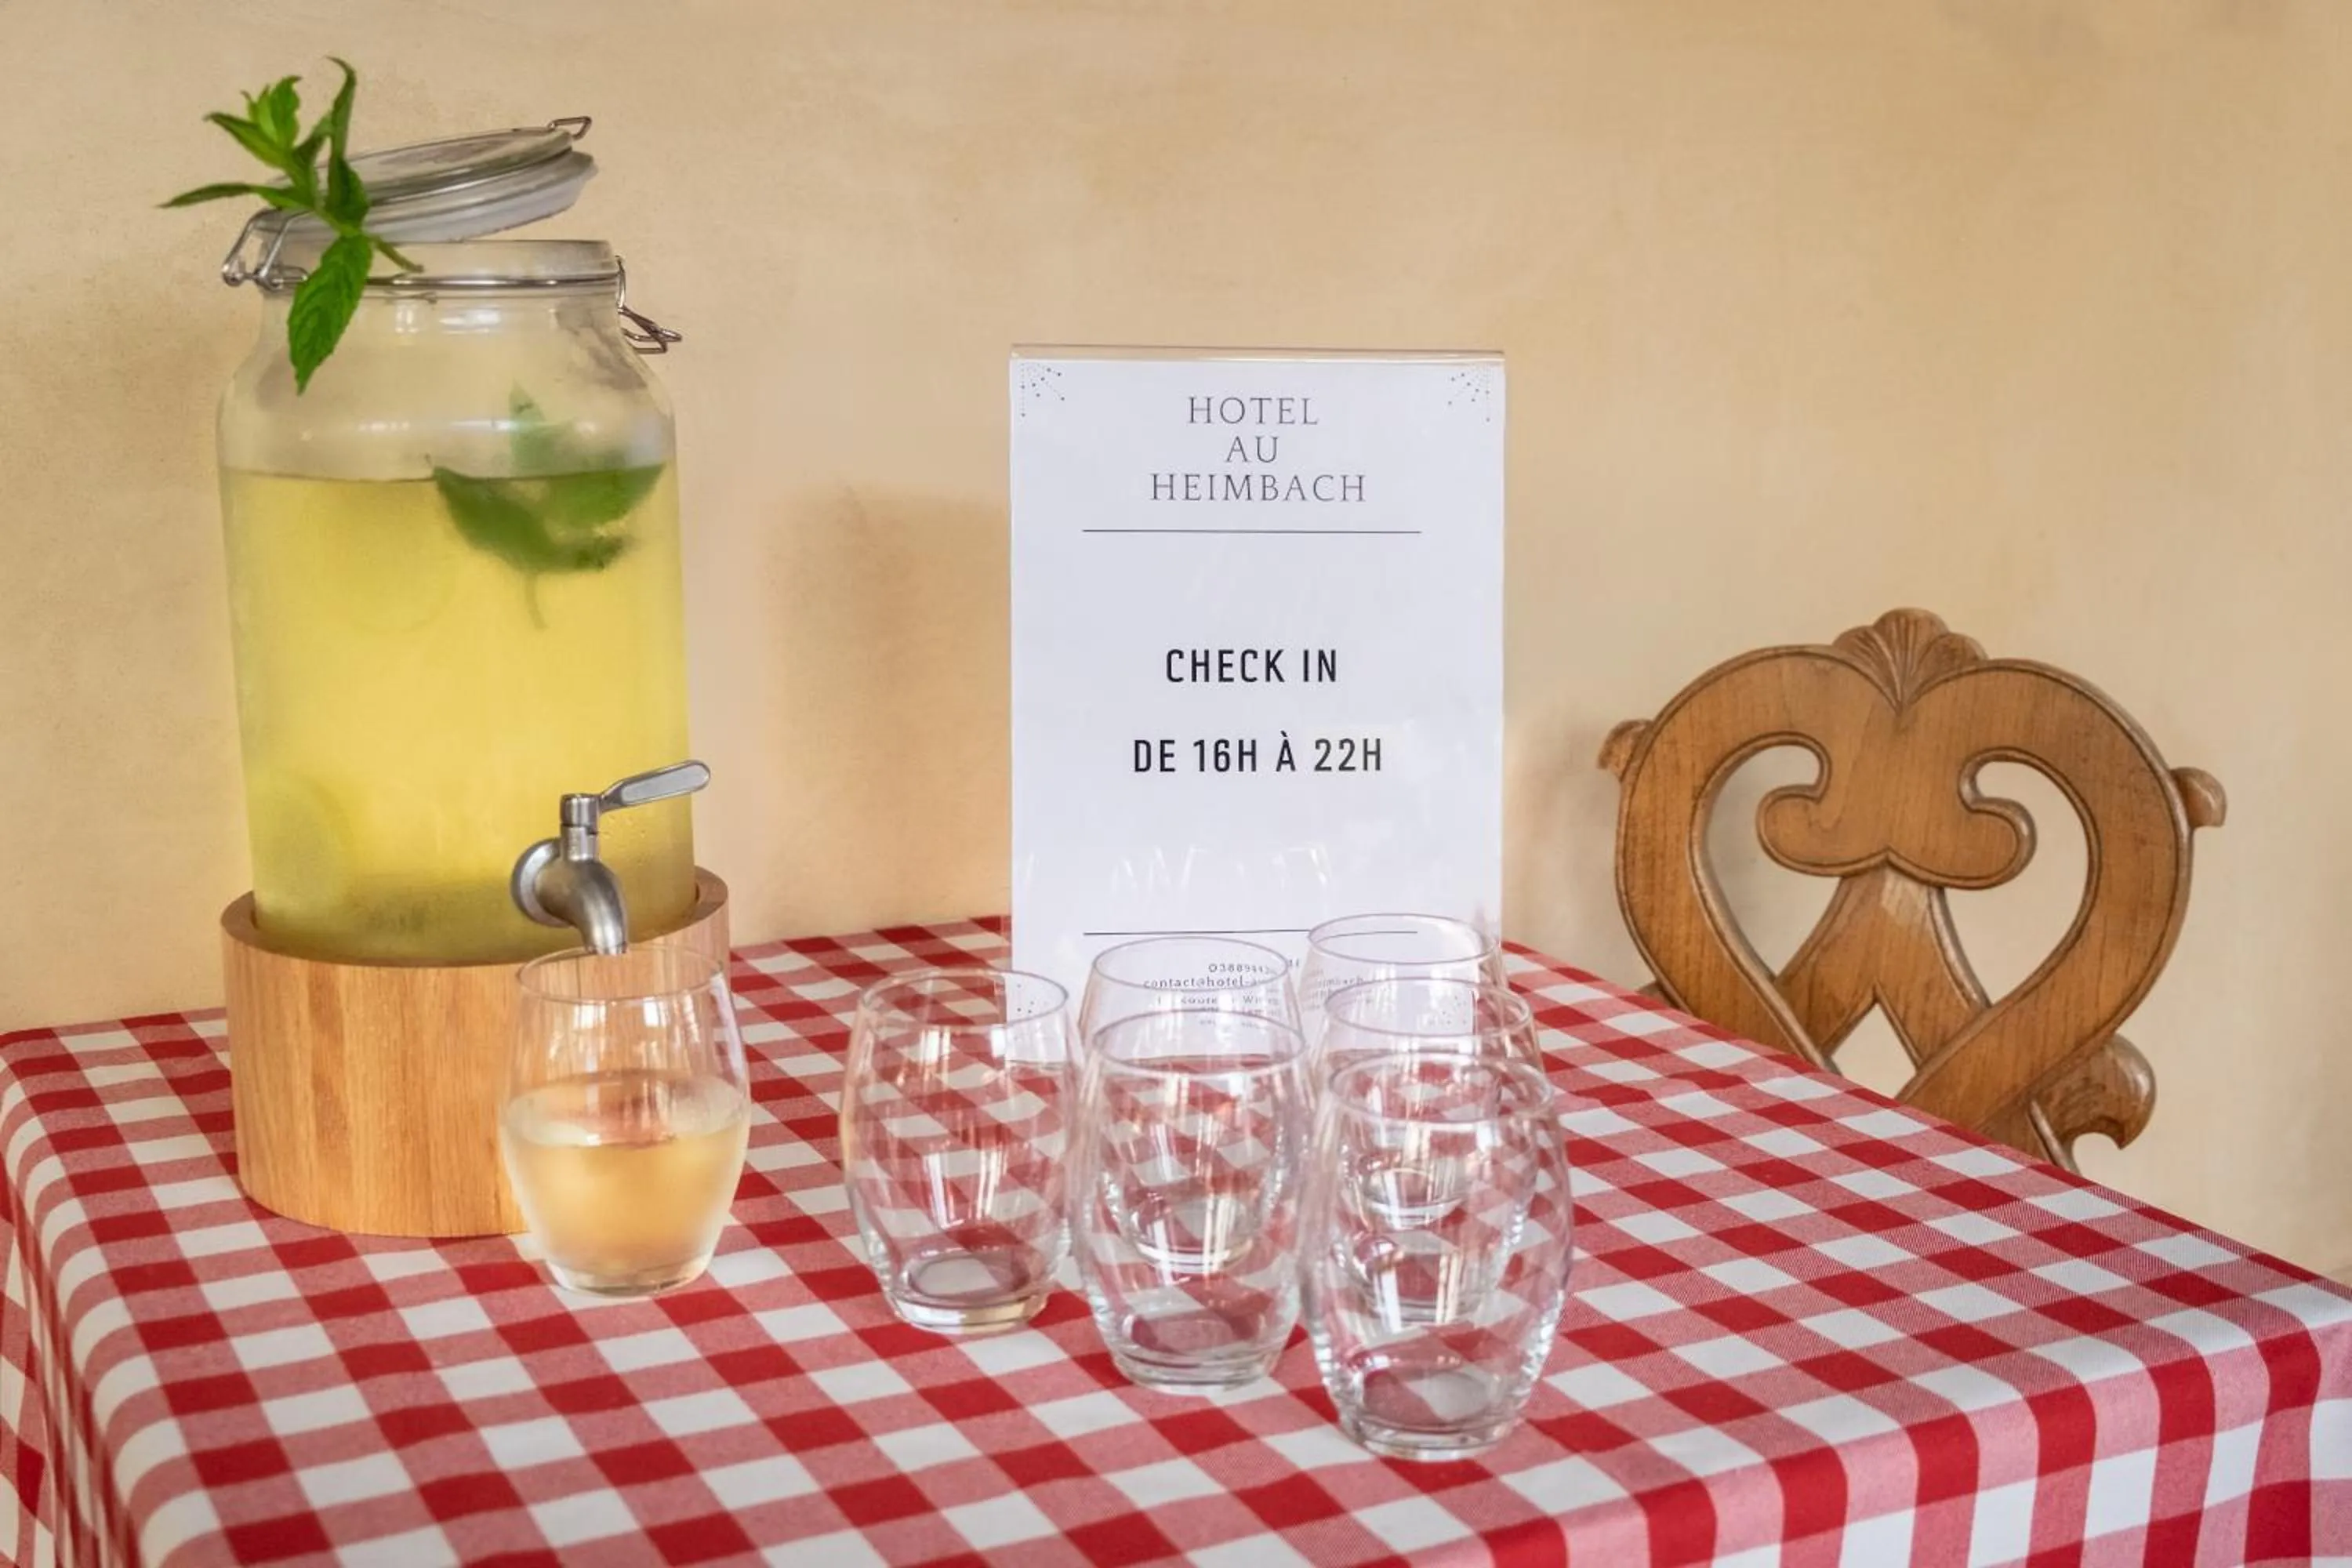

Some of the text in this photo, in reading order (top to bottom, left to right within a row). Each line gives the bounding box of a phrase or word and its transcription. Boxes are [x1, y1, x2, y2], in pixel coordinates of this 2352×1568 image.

[1188, 396, 1319, 426] HOTEL
[1225, 435, 1279, 463] AU
[1150, 473, 1367, 502] HEIMBACH
[1165, 648, 1338, 684] CHECK IN
[1134, 730, 1382, 773] DE 16H À 22H
